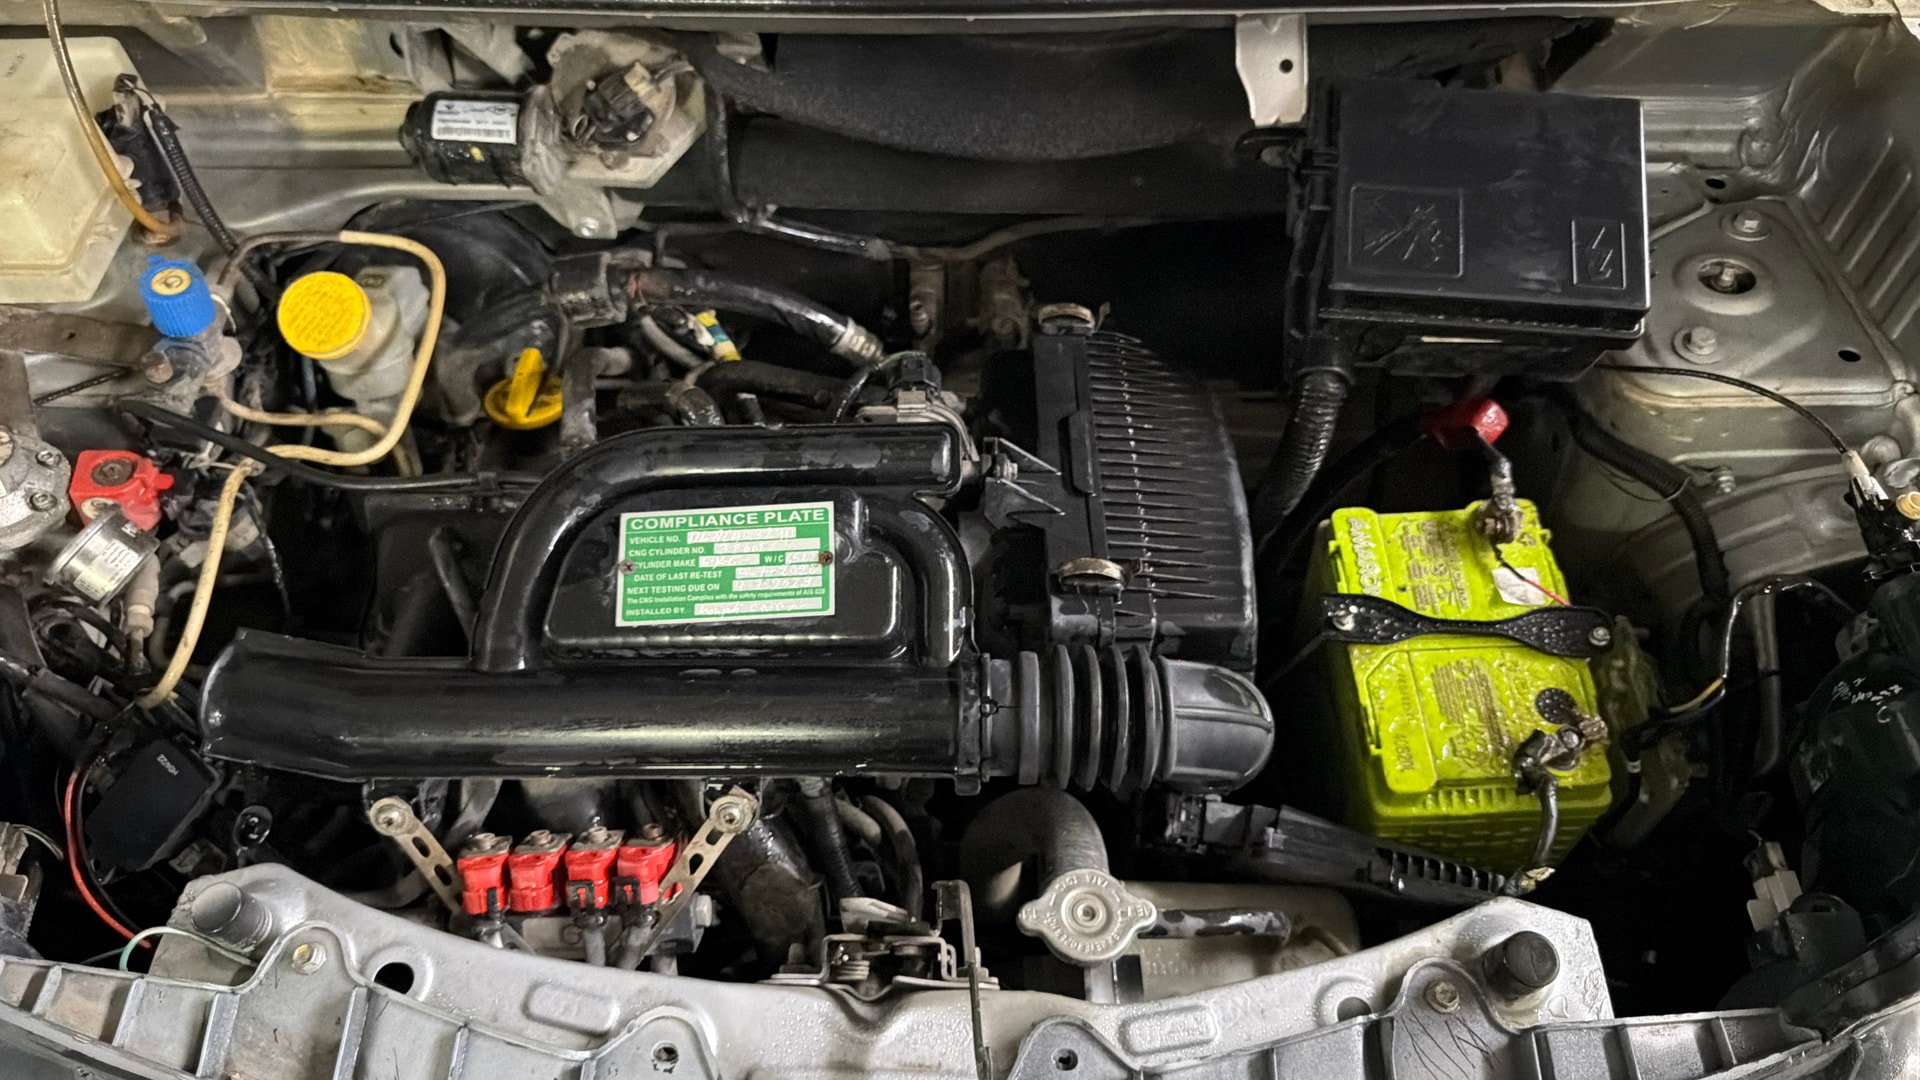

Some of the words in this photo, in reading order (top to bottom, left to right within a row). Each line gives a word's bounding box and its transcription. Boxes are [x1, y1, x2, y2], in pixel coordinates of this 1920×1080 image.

[631, 513, 759, 530] COMPLIANCE
[764, 509, 825, 524] PLATE
[629, 536, 664, 545] VEHICLE
[628, 549, 647, 557] CNG
[648, 547, 690, 556] CYLINDER
[673, 559, 696, 567] MAKE
[634, 574, 654, 582] DATE
[655, 573, 667, 581] OF
[668, 572, 688, 580] LAST
[689, 570, 722, 579] RE-TEST
[627, 587, 649, 595] NEXT
[651, 585, 686, 594] TESTING
[688, 584, 705, 592] DUE
[707, 583, 720, 591] ON
[626, 607, 671, 616] INSTALLED
